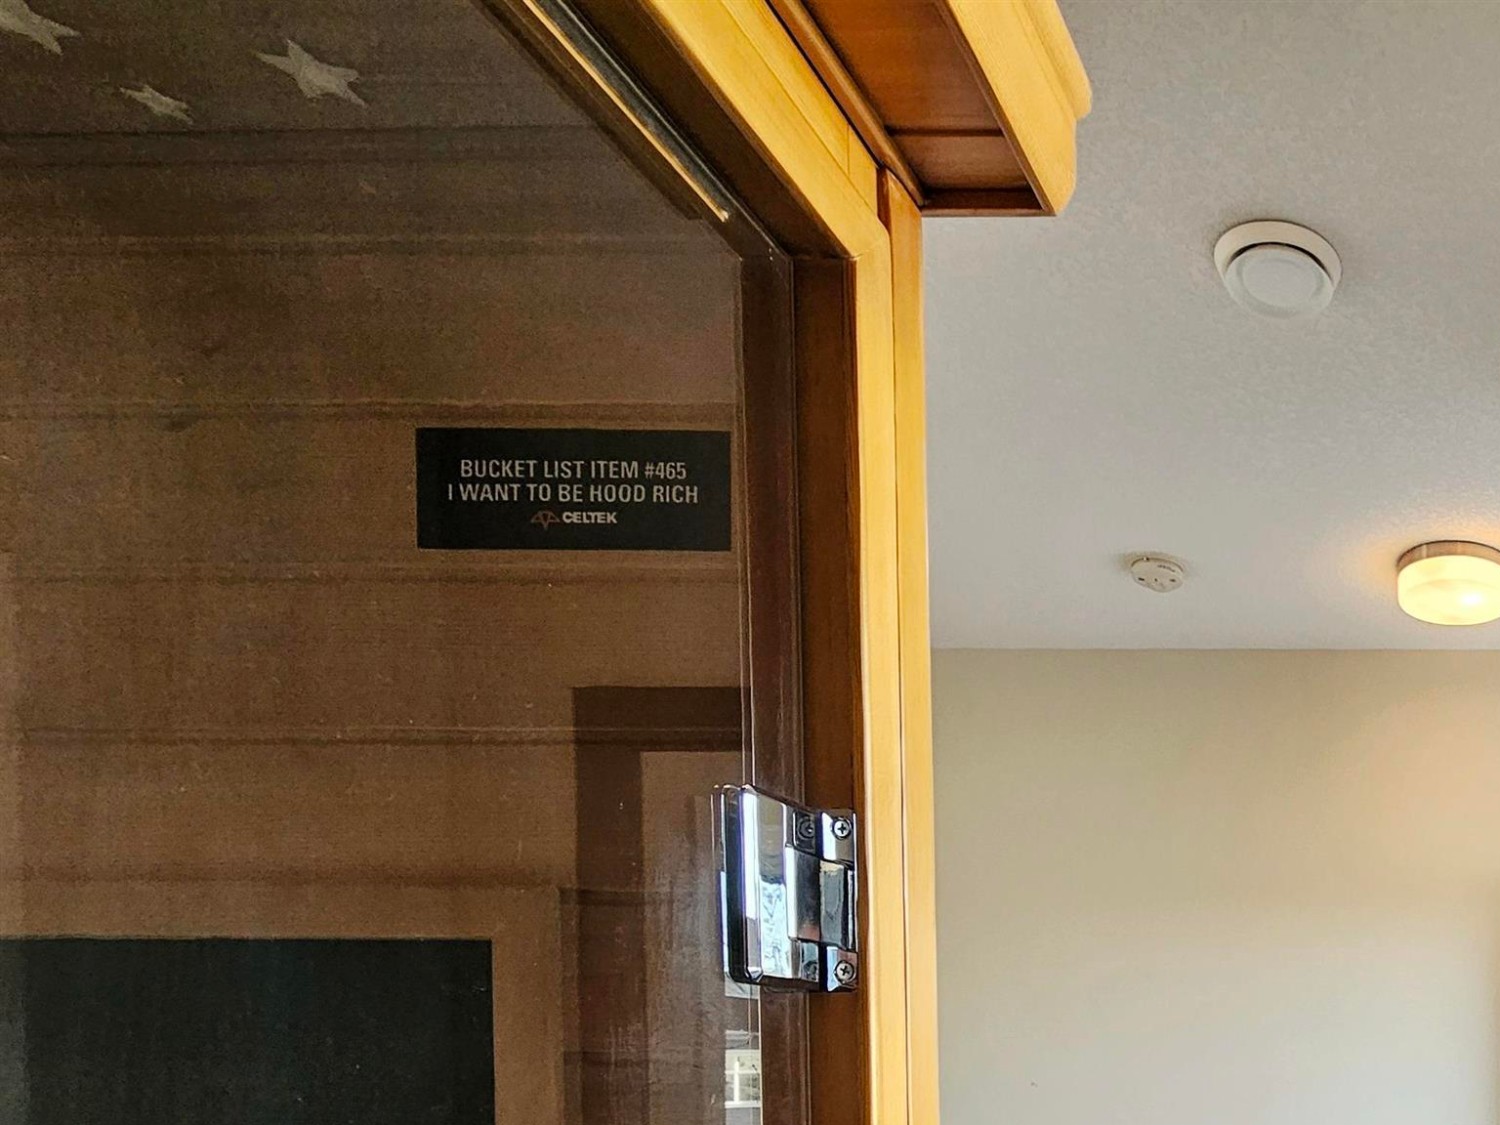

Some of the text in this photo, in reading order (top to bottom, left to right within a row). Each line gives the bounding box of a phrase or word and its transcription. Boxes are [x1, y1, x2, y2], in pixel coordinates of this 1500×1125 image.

[460, 459, 687, 480] BUCKET LIST ITEM #465
[448, 483, 698, 504] I WANT TO BE HOOD RICH
[562, 511, 618, 524] CELTEK
